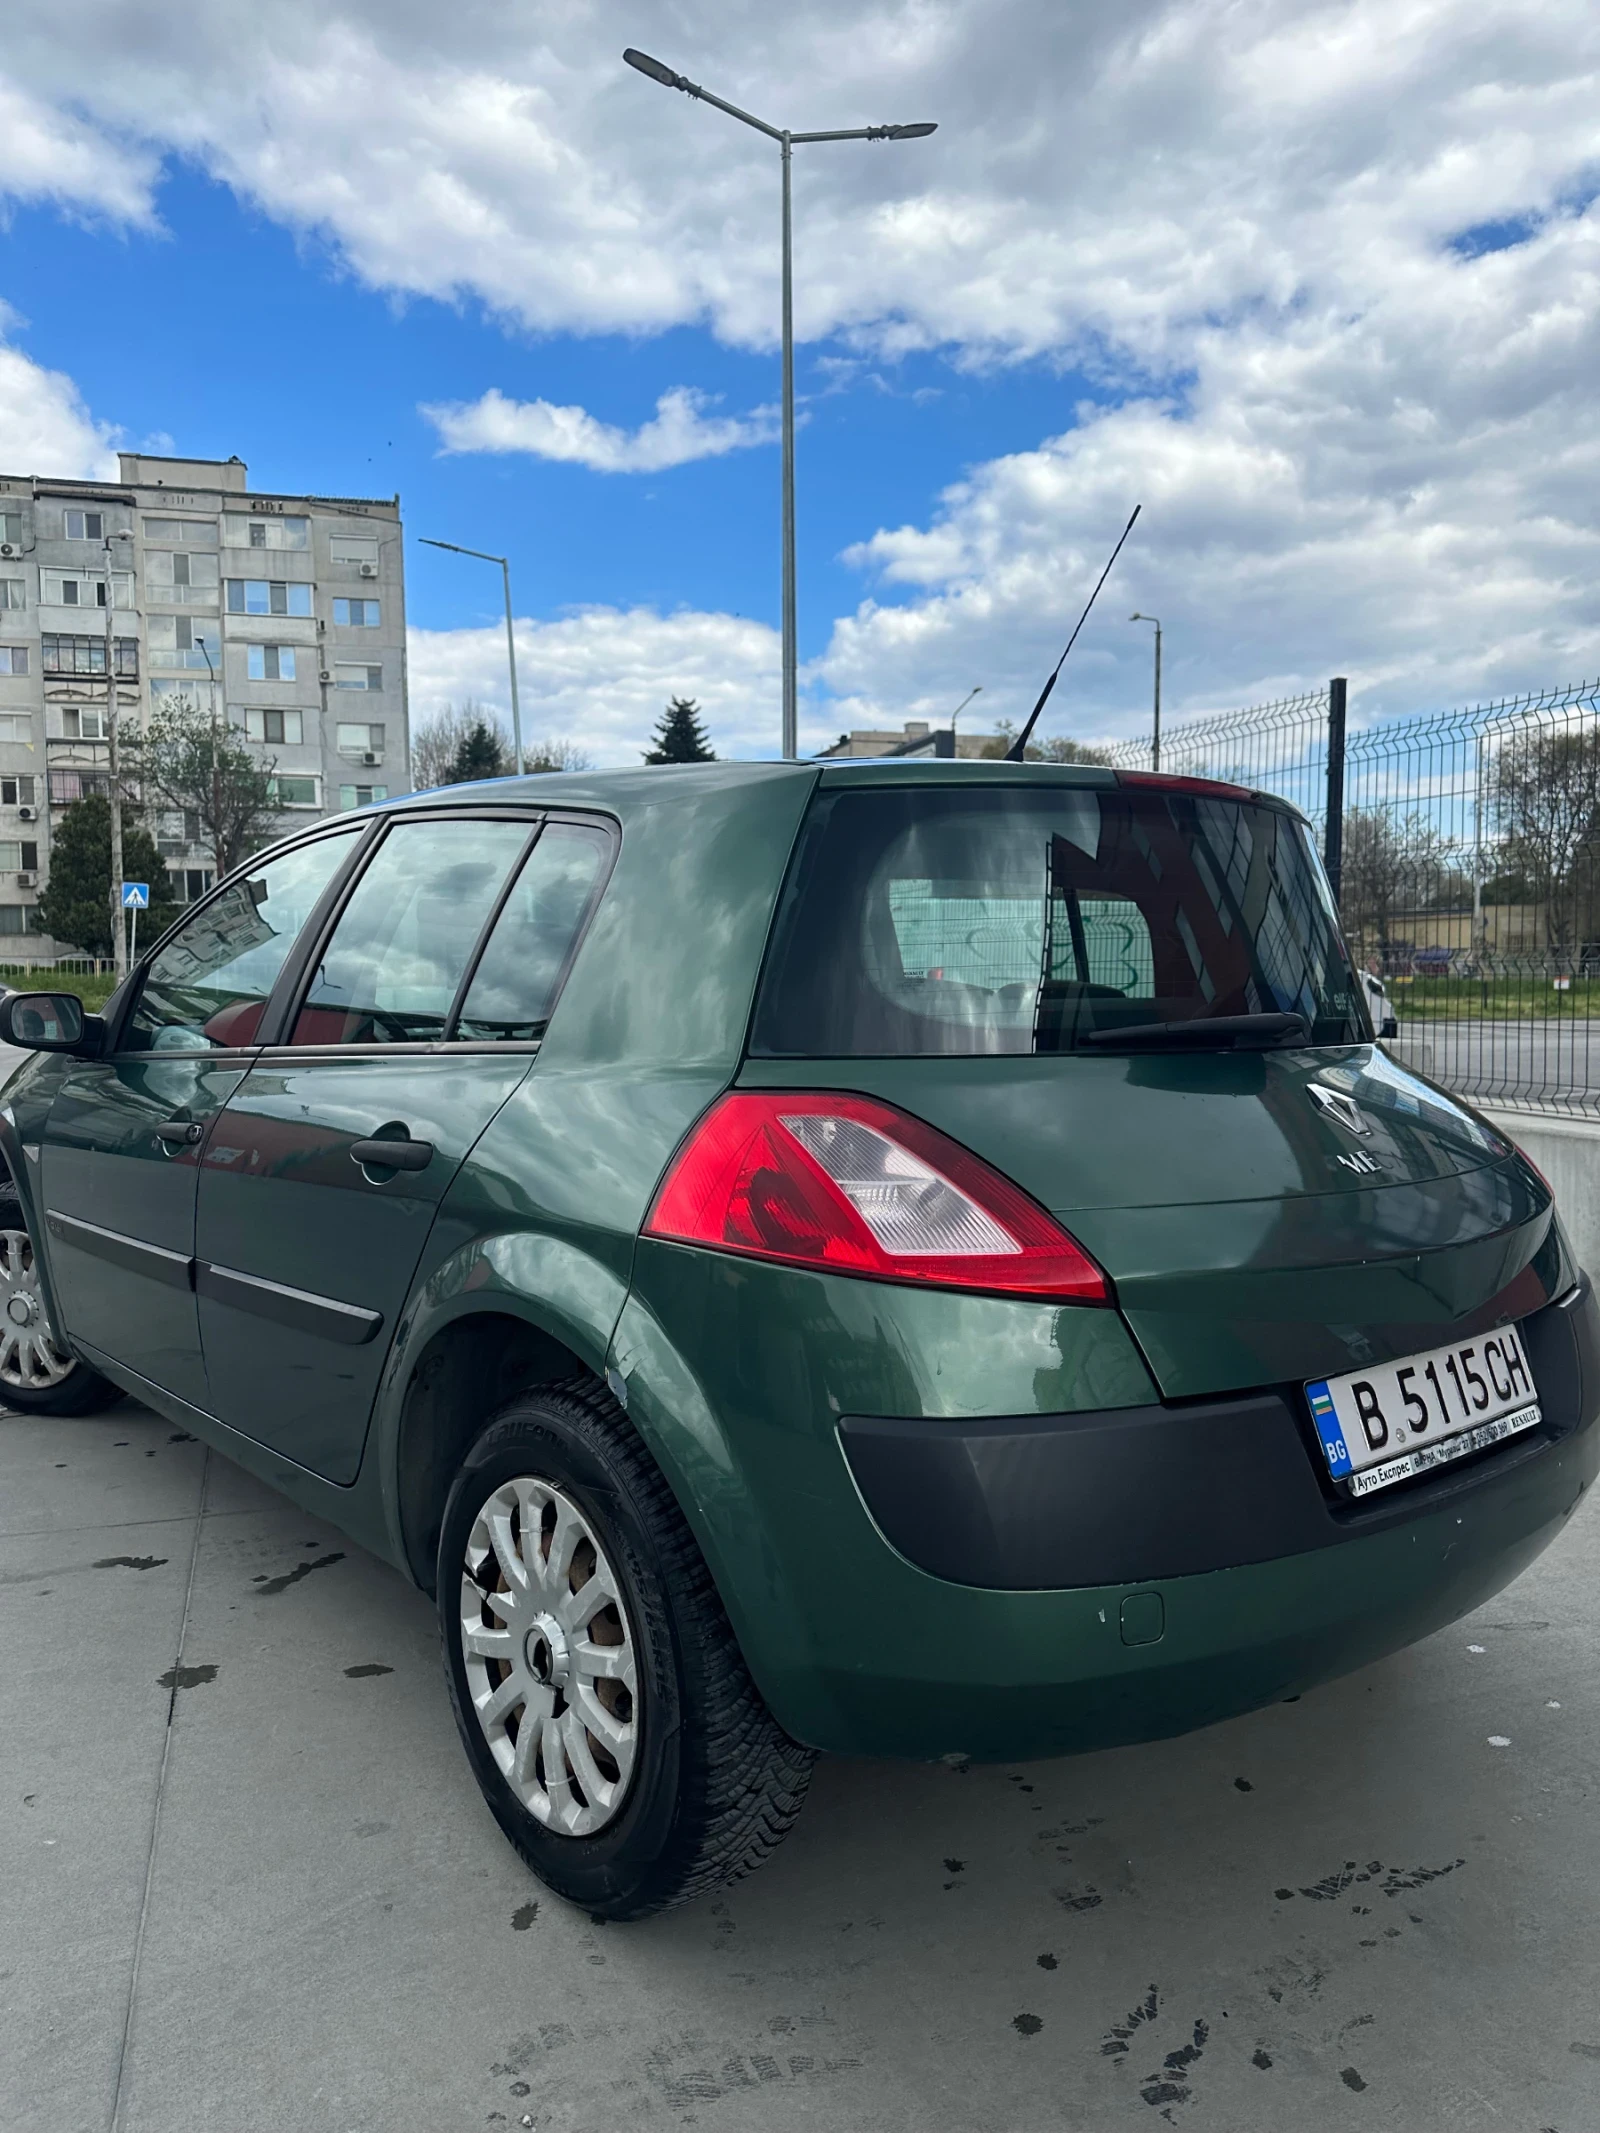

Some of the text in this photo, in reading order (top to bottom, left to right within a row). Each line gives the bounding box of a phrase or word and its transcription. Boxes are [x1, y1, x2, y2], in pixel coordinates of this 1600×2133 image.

[1351, 1381, 1388, 1451] B
[1357, 1475, 1378, 1491] Ауто
[1377, 1462, 1411, 1482] Експрес
[1511, 1410, 1537, 1429] RENAULT
[1325, 1439, 1347, 1464] BG
